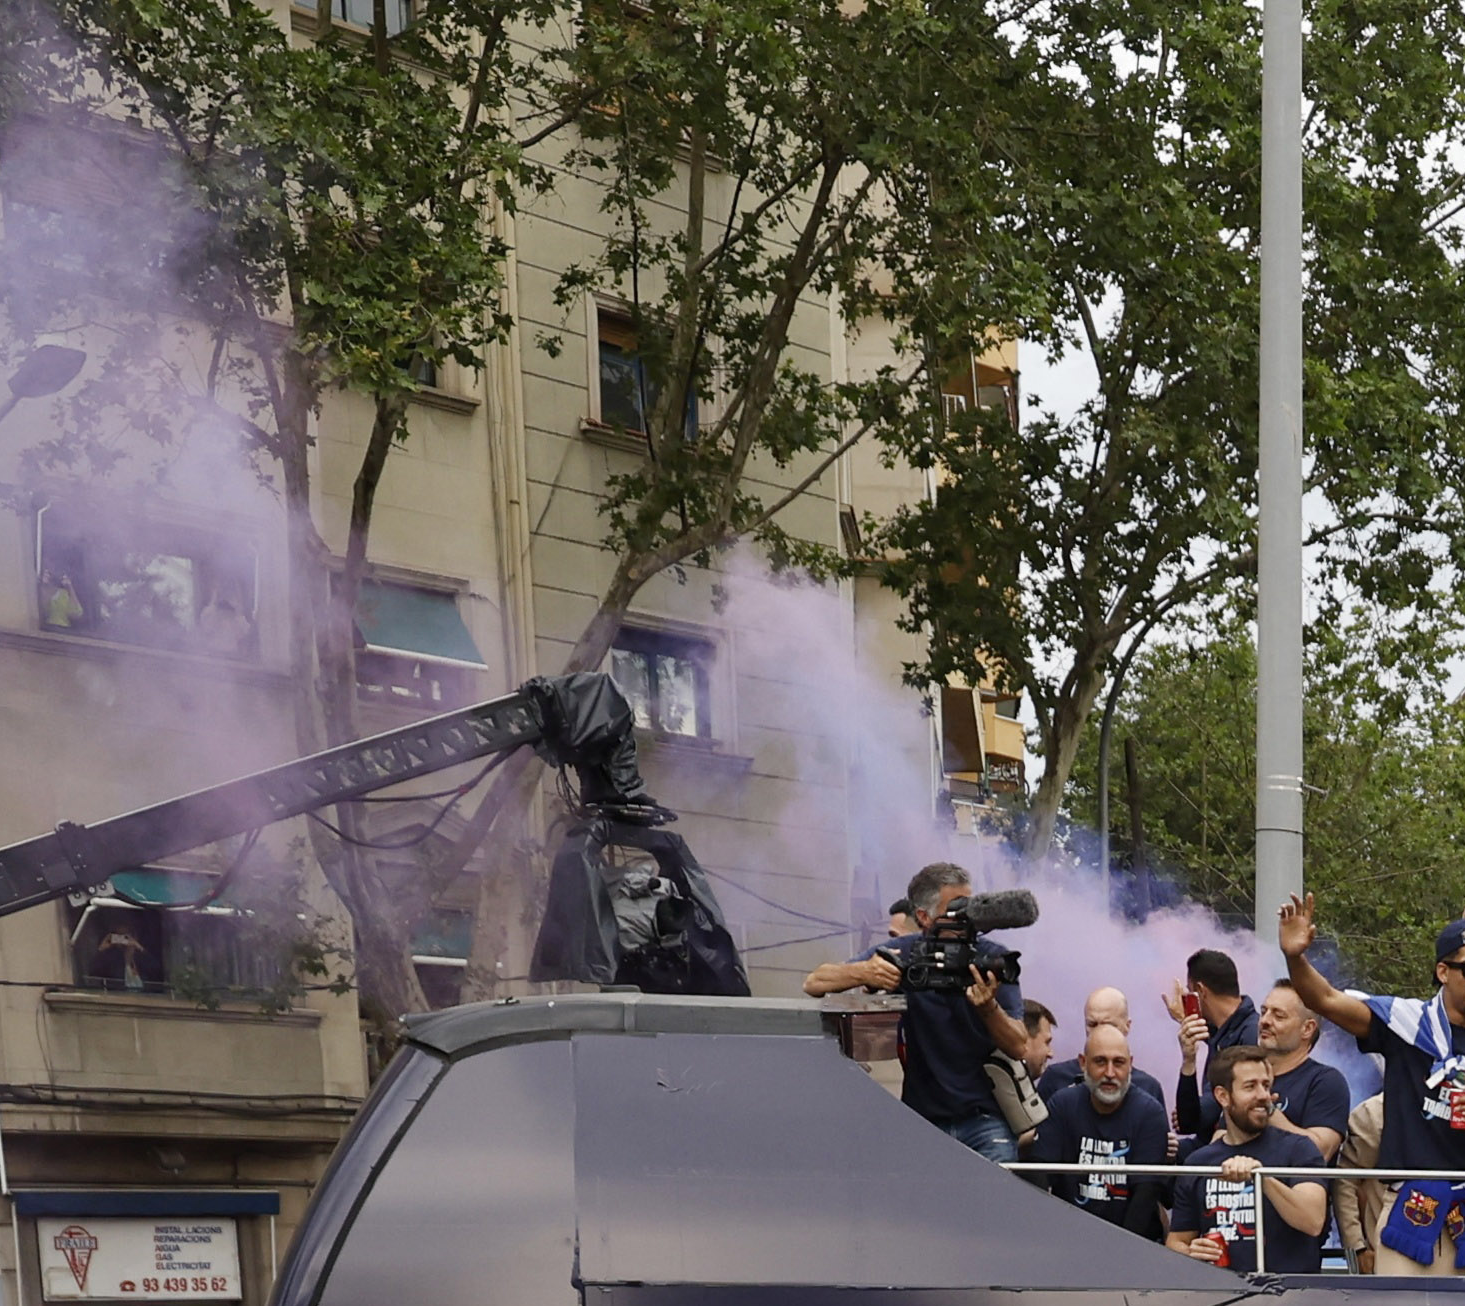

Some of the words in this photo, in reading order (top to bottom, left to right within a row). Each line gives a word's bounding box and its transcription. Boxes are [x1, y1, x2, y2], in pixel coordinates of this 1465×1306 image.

[143, 1277, 160, 1292] 93
[164, 1277, 188, 1292] 439
[191, 1277, 208, 1292] 35
[211, 1277, 227, 1292] 62
